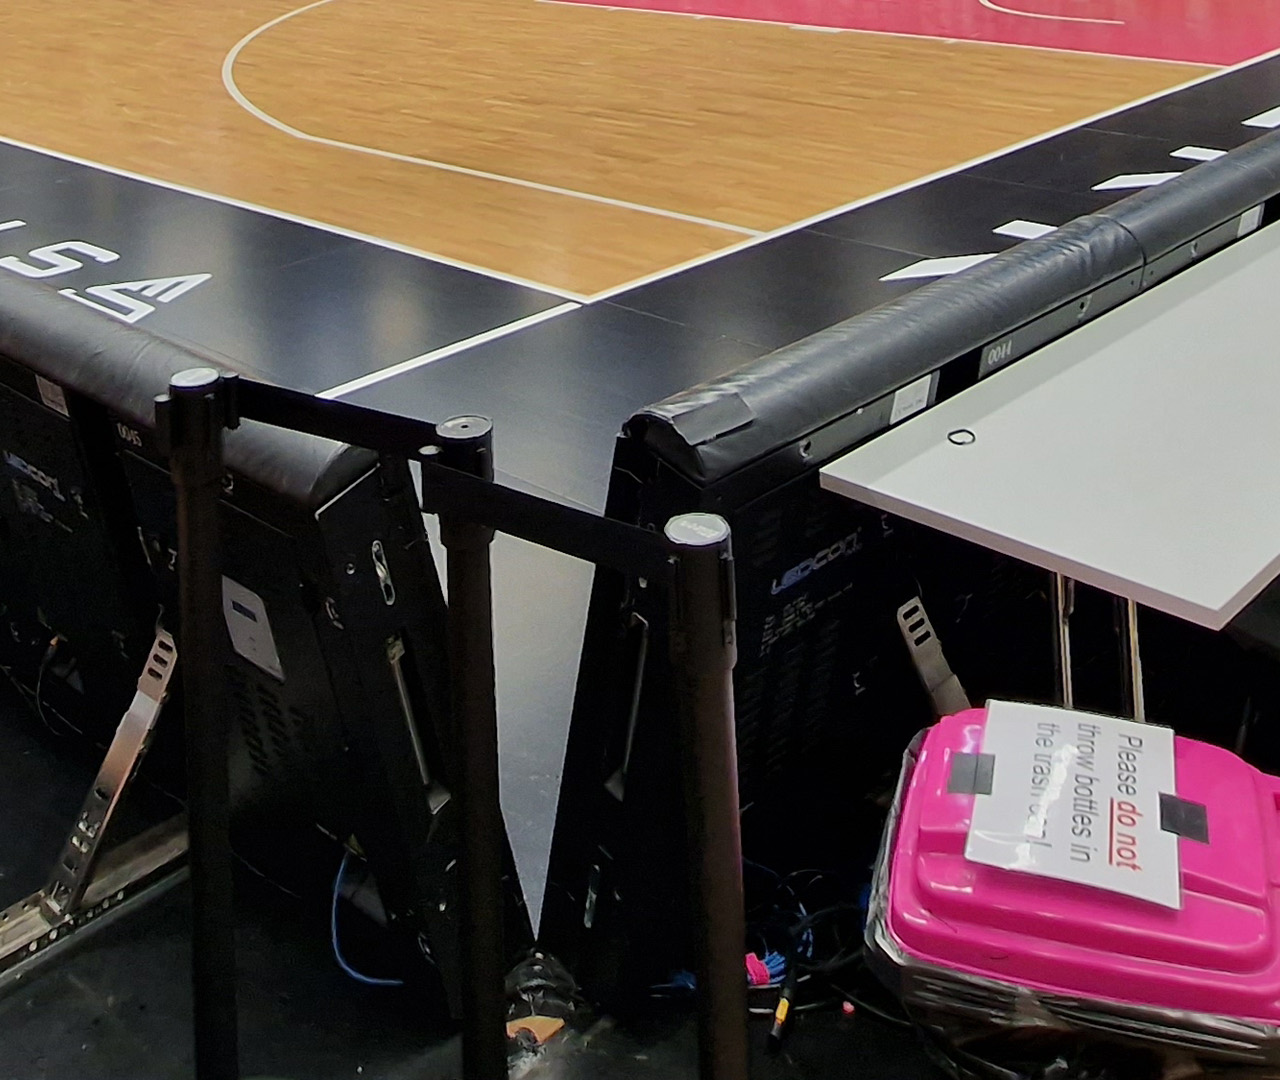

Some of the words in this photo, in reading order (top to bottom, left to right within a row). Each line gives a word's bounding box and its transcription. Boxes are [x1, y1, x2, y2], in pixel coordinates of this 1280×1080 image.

[1035, 722, 1061, 748] the
[1074, 722, 1101, 772] throw
[1117, 733, 1143, 797] Please
[1070, 773, 1101, 839] bottles
[1117, 799, 1144, 828] do
[1069, 841, 1098, 863] in
[1115, 831, 1143, 872] not
